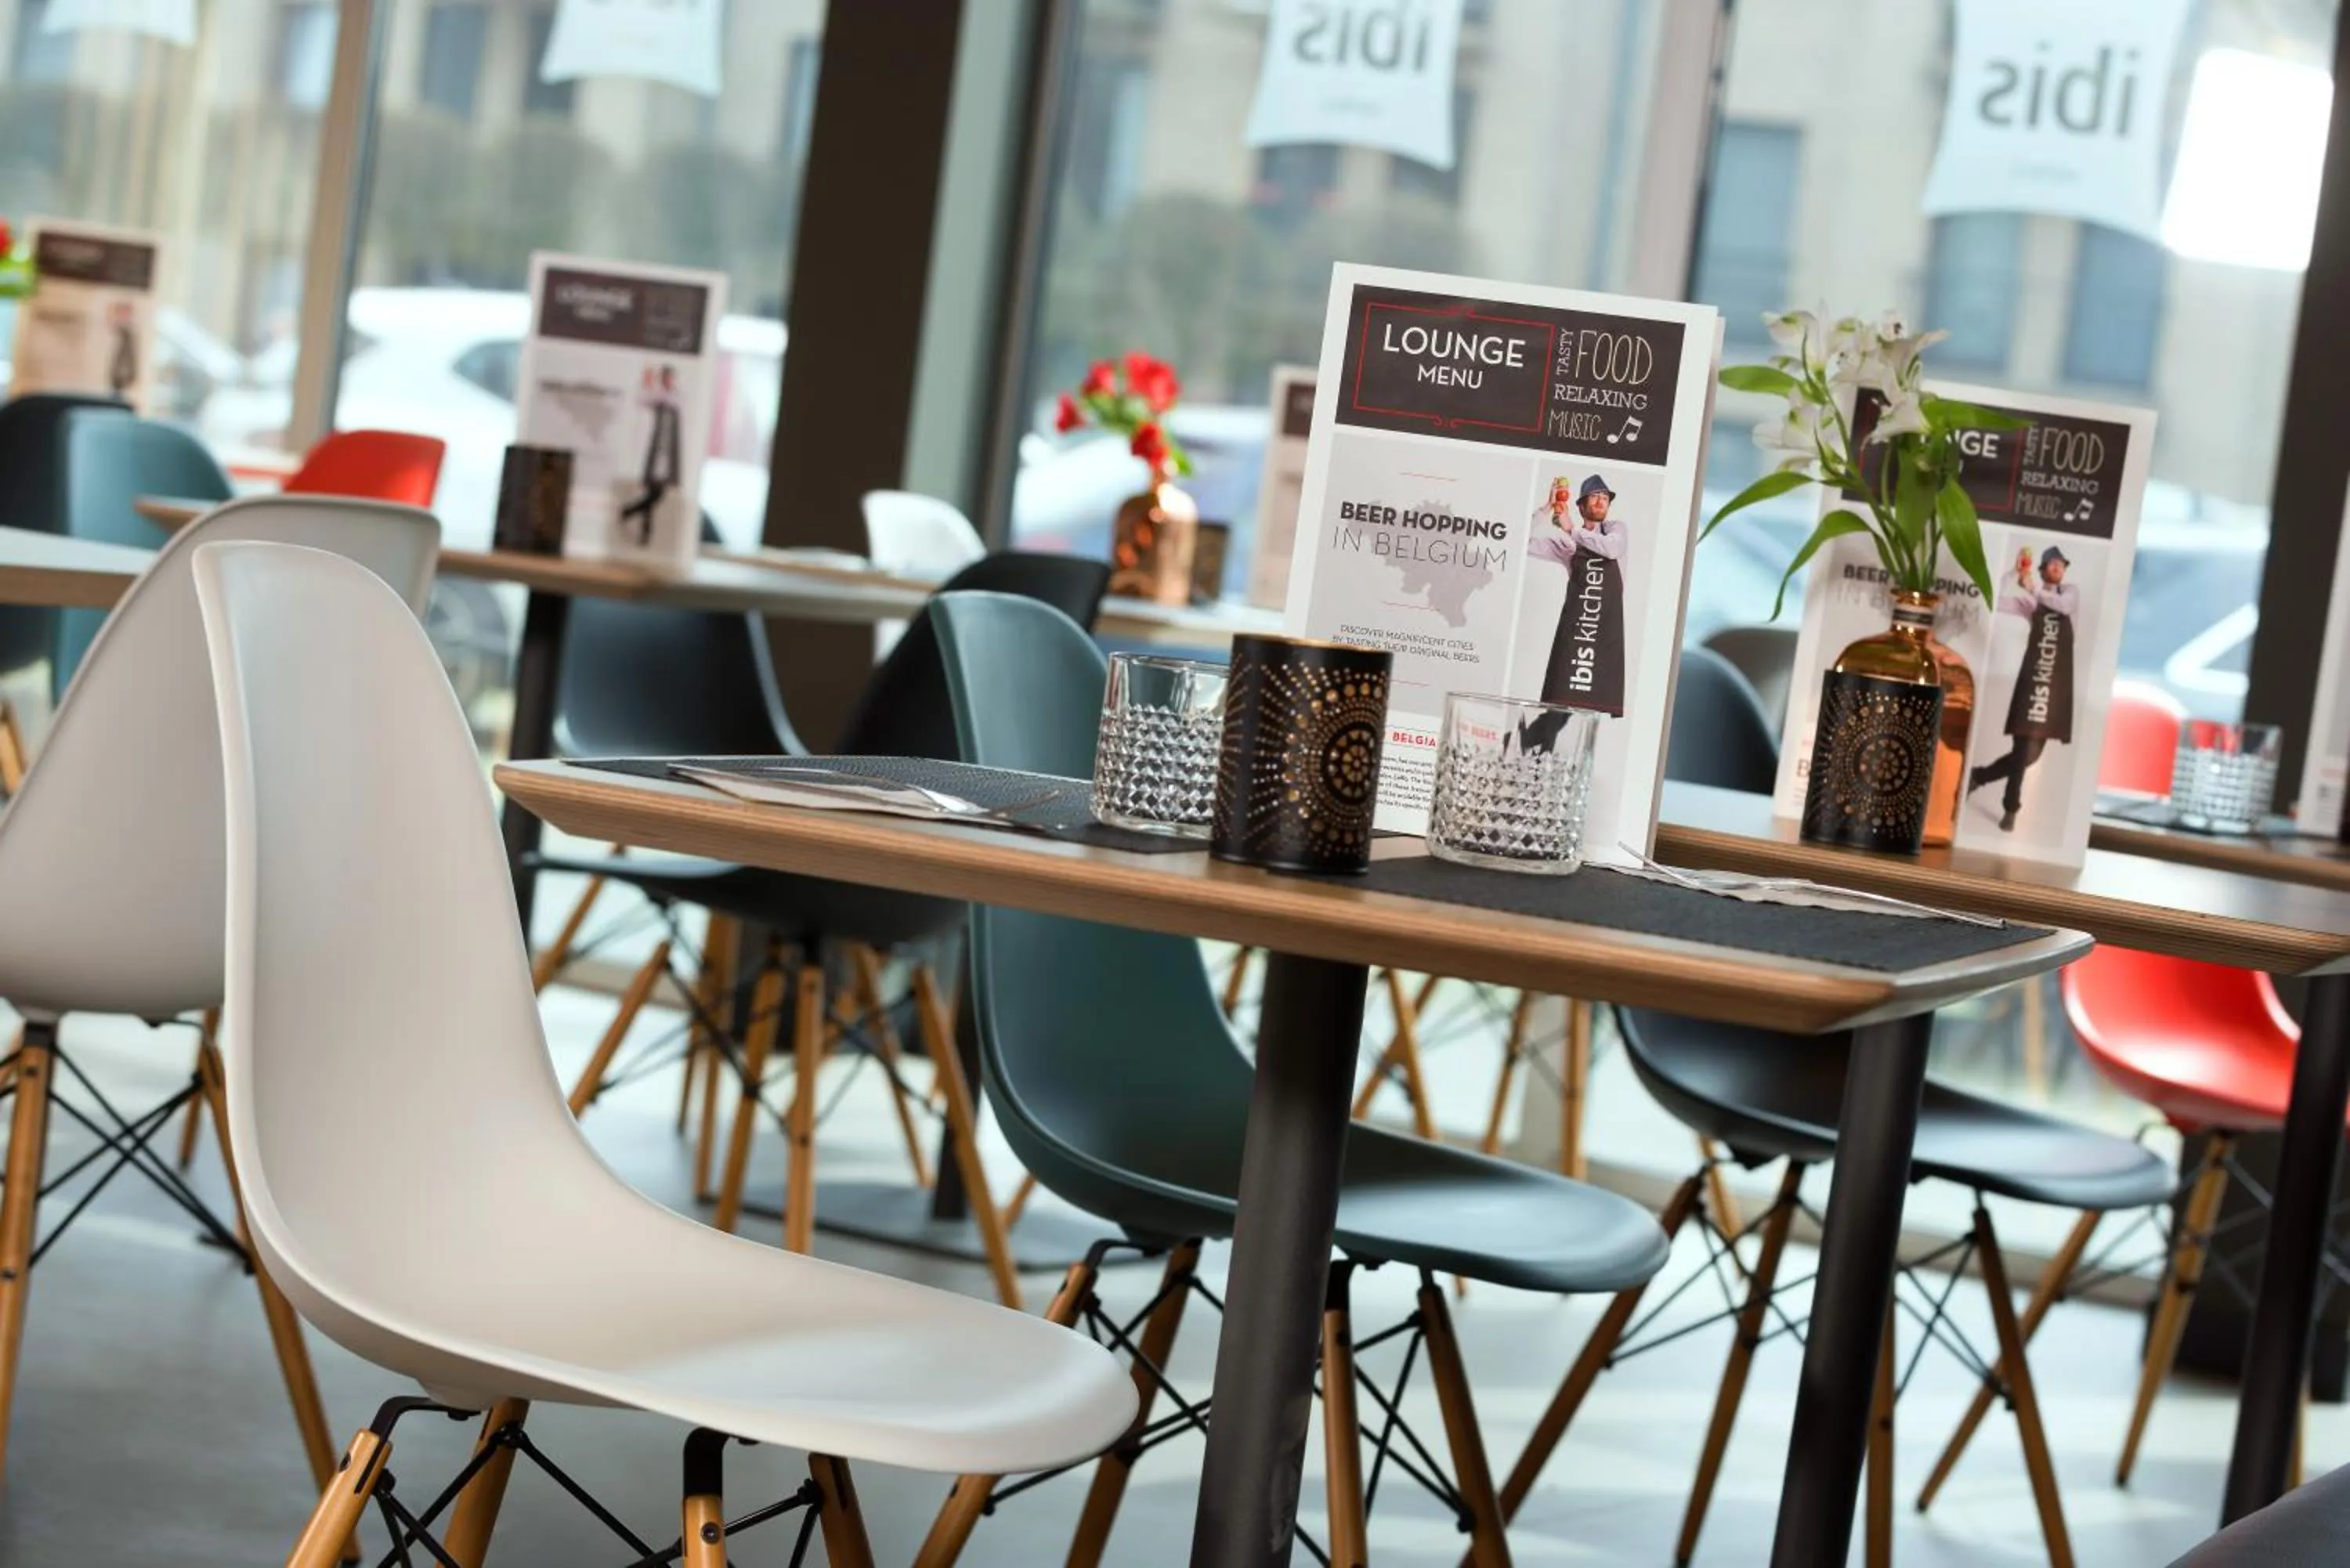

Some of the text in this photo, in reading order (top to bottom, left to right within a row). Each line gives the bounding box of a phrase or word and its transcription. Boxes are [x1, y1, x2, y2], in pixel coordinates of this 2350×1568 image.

[1383, 323, 1527, 369] LOUNGE
[1556, 328, 1574, 376] TASTY
[1575, 329, 1653, 385] FOOD
[1417, 363, 1484, 389] MENU
[1553, 383, 1647, 410] RELAXING
[1547, 408, 1602, 441] MUSIC
[2038, 426, 2105, 475] FOOD
[2020, 470, 2099, 495] RELAXING
[1340, 500, 1508, 541] BEER HOPPING
[2015, 492, 2062, 520] MUSIC
[1332, 525, 1508, 572] IN BELGIUM
[1843, 563, 1890, 585] BEER
[1340, 624, 1384, 638] DISCOVER
[1385, 630, 1446, 647] MAGNIFICENT
[1569, 558, 1604, 692] ibis kitchen
[2026, 612, 2059, 724] ibis kitchen
[1391, 731, 1437, 747] BELGIA
